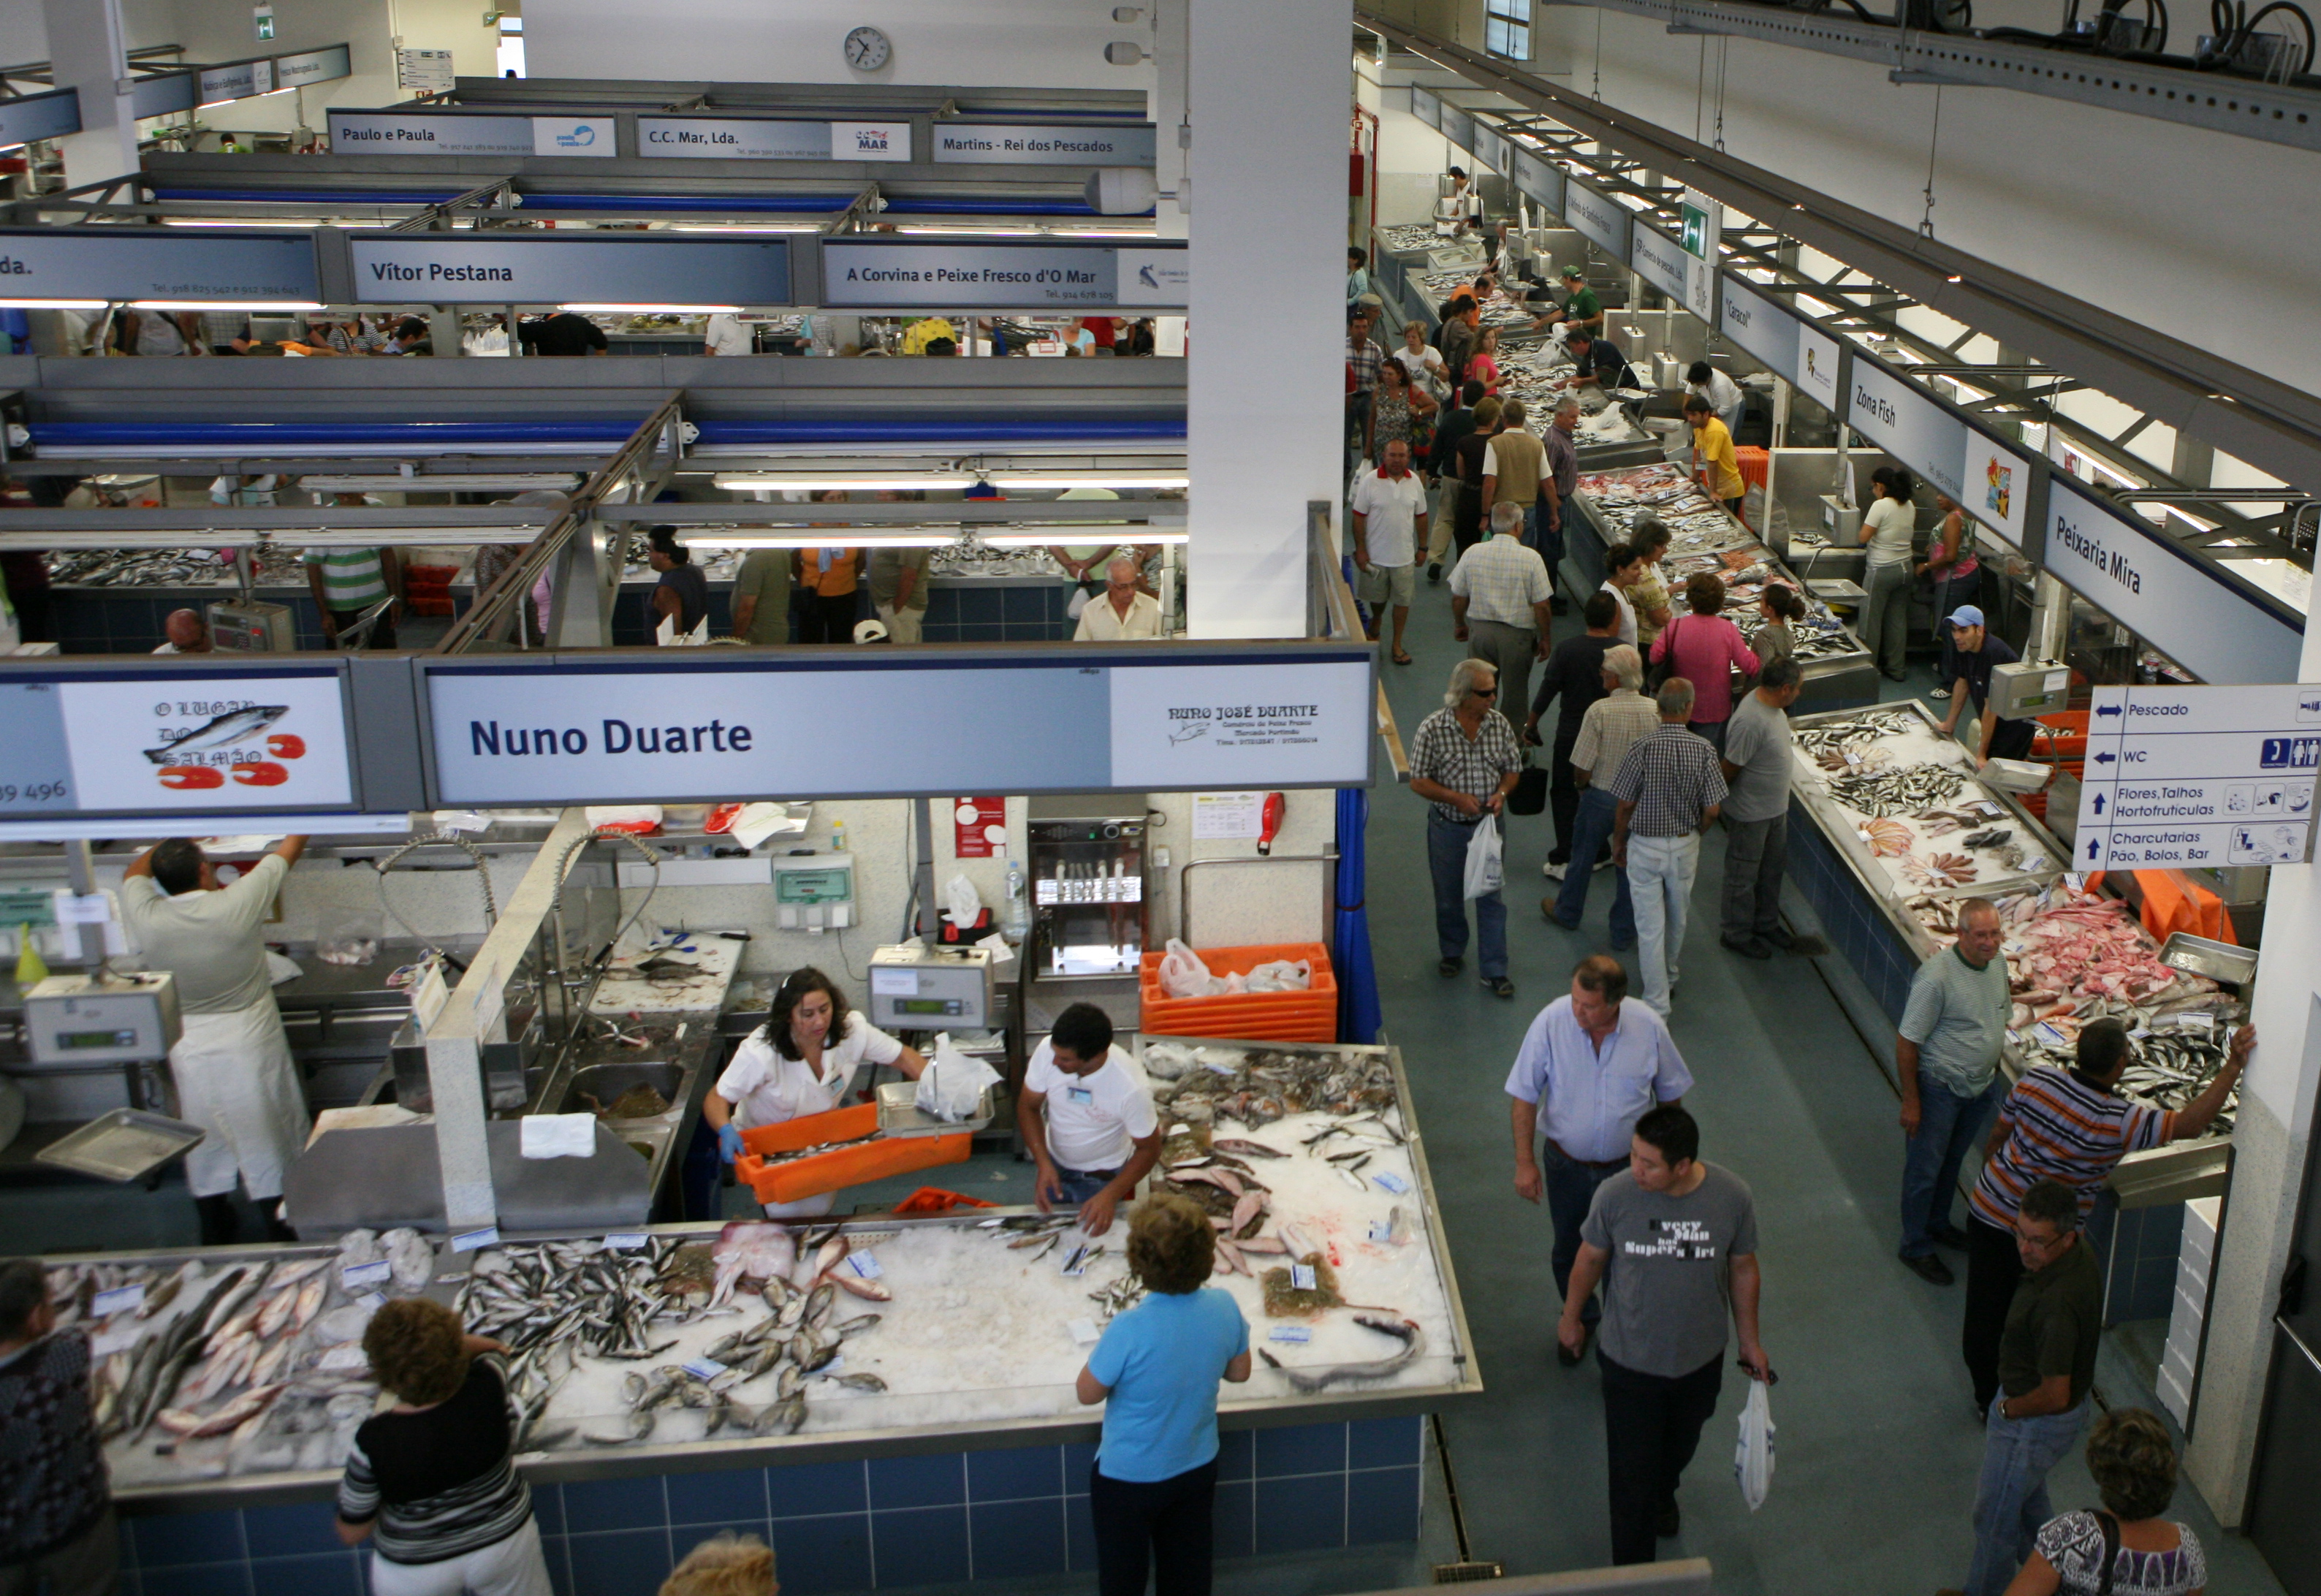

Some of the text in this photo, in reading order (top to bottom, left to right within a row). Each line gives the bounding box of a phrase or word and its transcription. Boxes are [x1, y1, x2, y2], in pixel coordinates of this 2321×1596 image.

[343, 128, 435, 141] Paulo e Paula
[650, 132, 739, 145] C.C. Mar, Lda.
[859, 140, 888, 149] MAR
[943, 139, 992, 151] Martins
[1004, 140, 1023, 151] Rei
[1027, 140, 1050, 151] dos
[1055, 140, 1113, 152] Pescados
[0, 256, 32, 274] da.
[371, 262, 513, 281] Vítor Pestana
[847, 268, 1097, 284] A Corvina e Peixe Fresco d'O Mar
[152, 284, 169, 292] Tel.
[1046, 290, 1060, 298] Tel.
[1081, 291, 1097, 300] 678
[1857, 384, 1896, 428] Zona Fish
[2056, 515, 2140, 595] Peixaria Mira
[156, 702, 171, 716] O
[1169, 704, 1318, 721] NUNO JOSÉ DUARTE
[2128, 704, 2189, 716] Pescado
[471, 719, 753, 756] Nuno Duarte
[164, 748, 262, 767] SALMÃO
[2123, 750, 2148, 763] WC
[26, 780, 67, 802] 496
[2112, 832, 2200, 844] Charcutarias
[2110, 848, 2209, 862] Pão, Bolos, Bar
